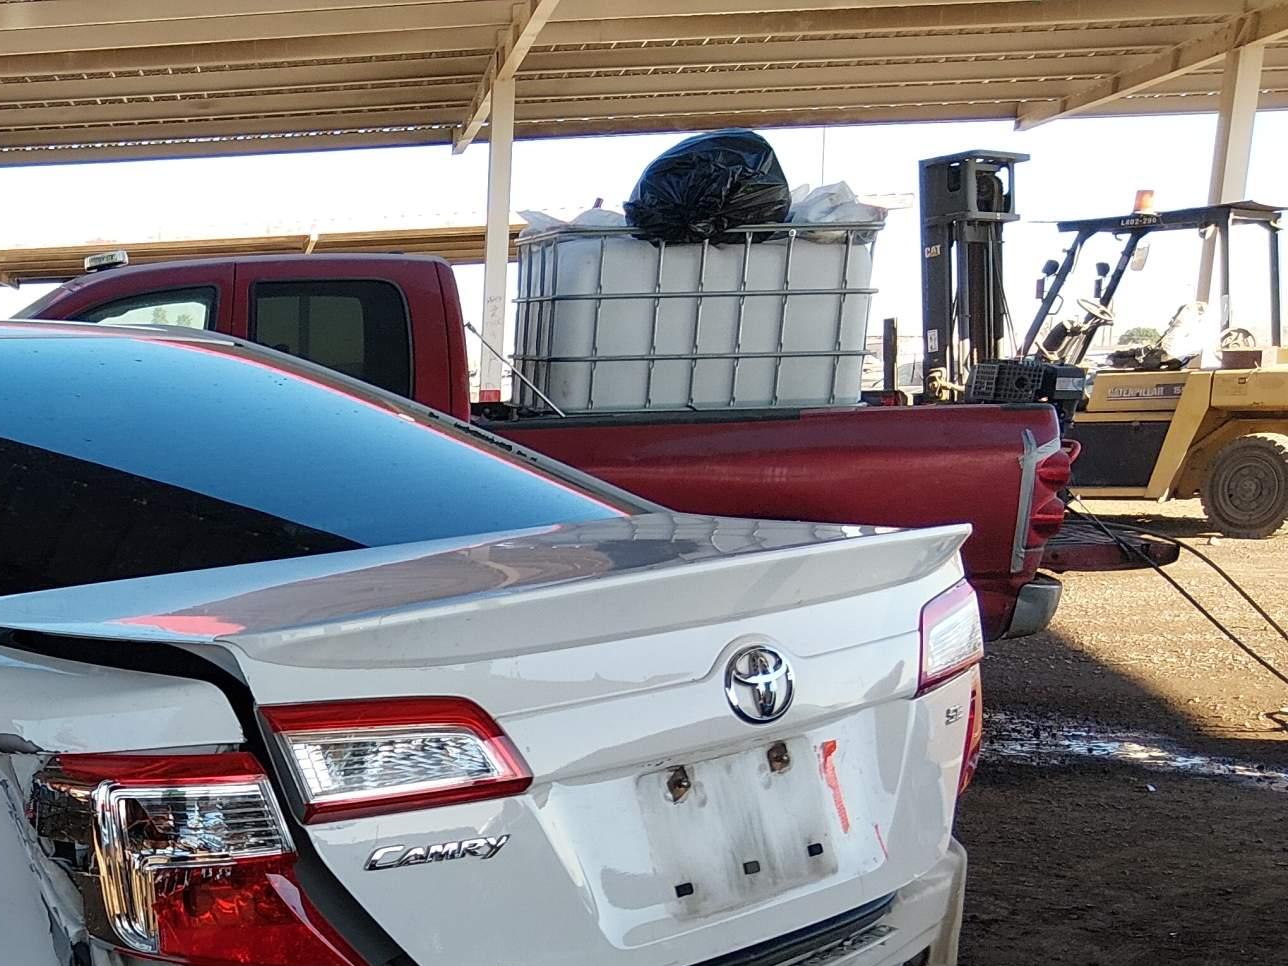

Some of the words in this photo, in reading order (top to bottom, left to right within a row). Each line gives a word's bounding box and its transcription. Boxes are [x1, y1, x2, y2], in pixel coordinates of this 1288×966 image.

[925, 244, 941, 258] CAT
[944, 705, 963, 726] SE
[363, 834, 510, 871] CAMRY
